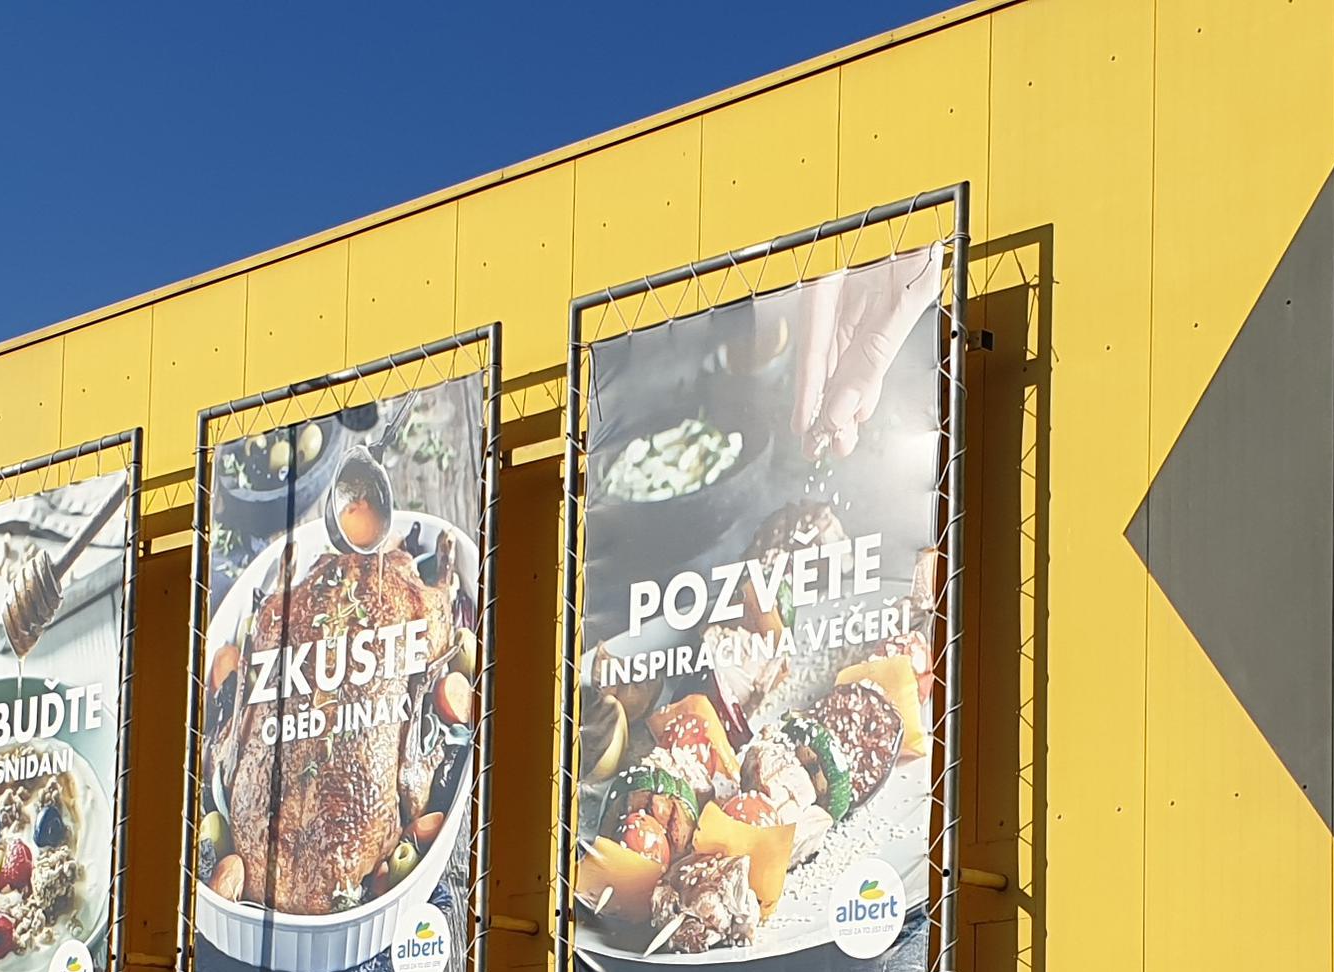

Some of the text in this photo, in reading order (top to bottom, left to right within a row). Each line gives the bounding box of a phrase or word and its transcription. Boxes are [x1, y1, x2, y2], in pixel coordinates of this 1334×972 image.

[628, 525, 883, 639] POZVĚTE
[246, 618, 430, 705] ZKUSTE
[599, 595, 912, 688] INSPIRACI NA VEČEŘI
[261, 692, 413, 746] OBĚD JINAK
[835, 895, 899, 923] albert
[396, 935, 445, 959] albert
